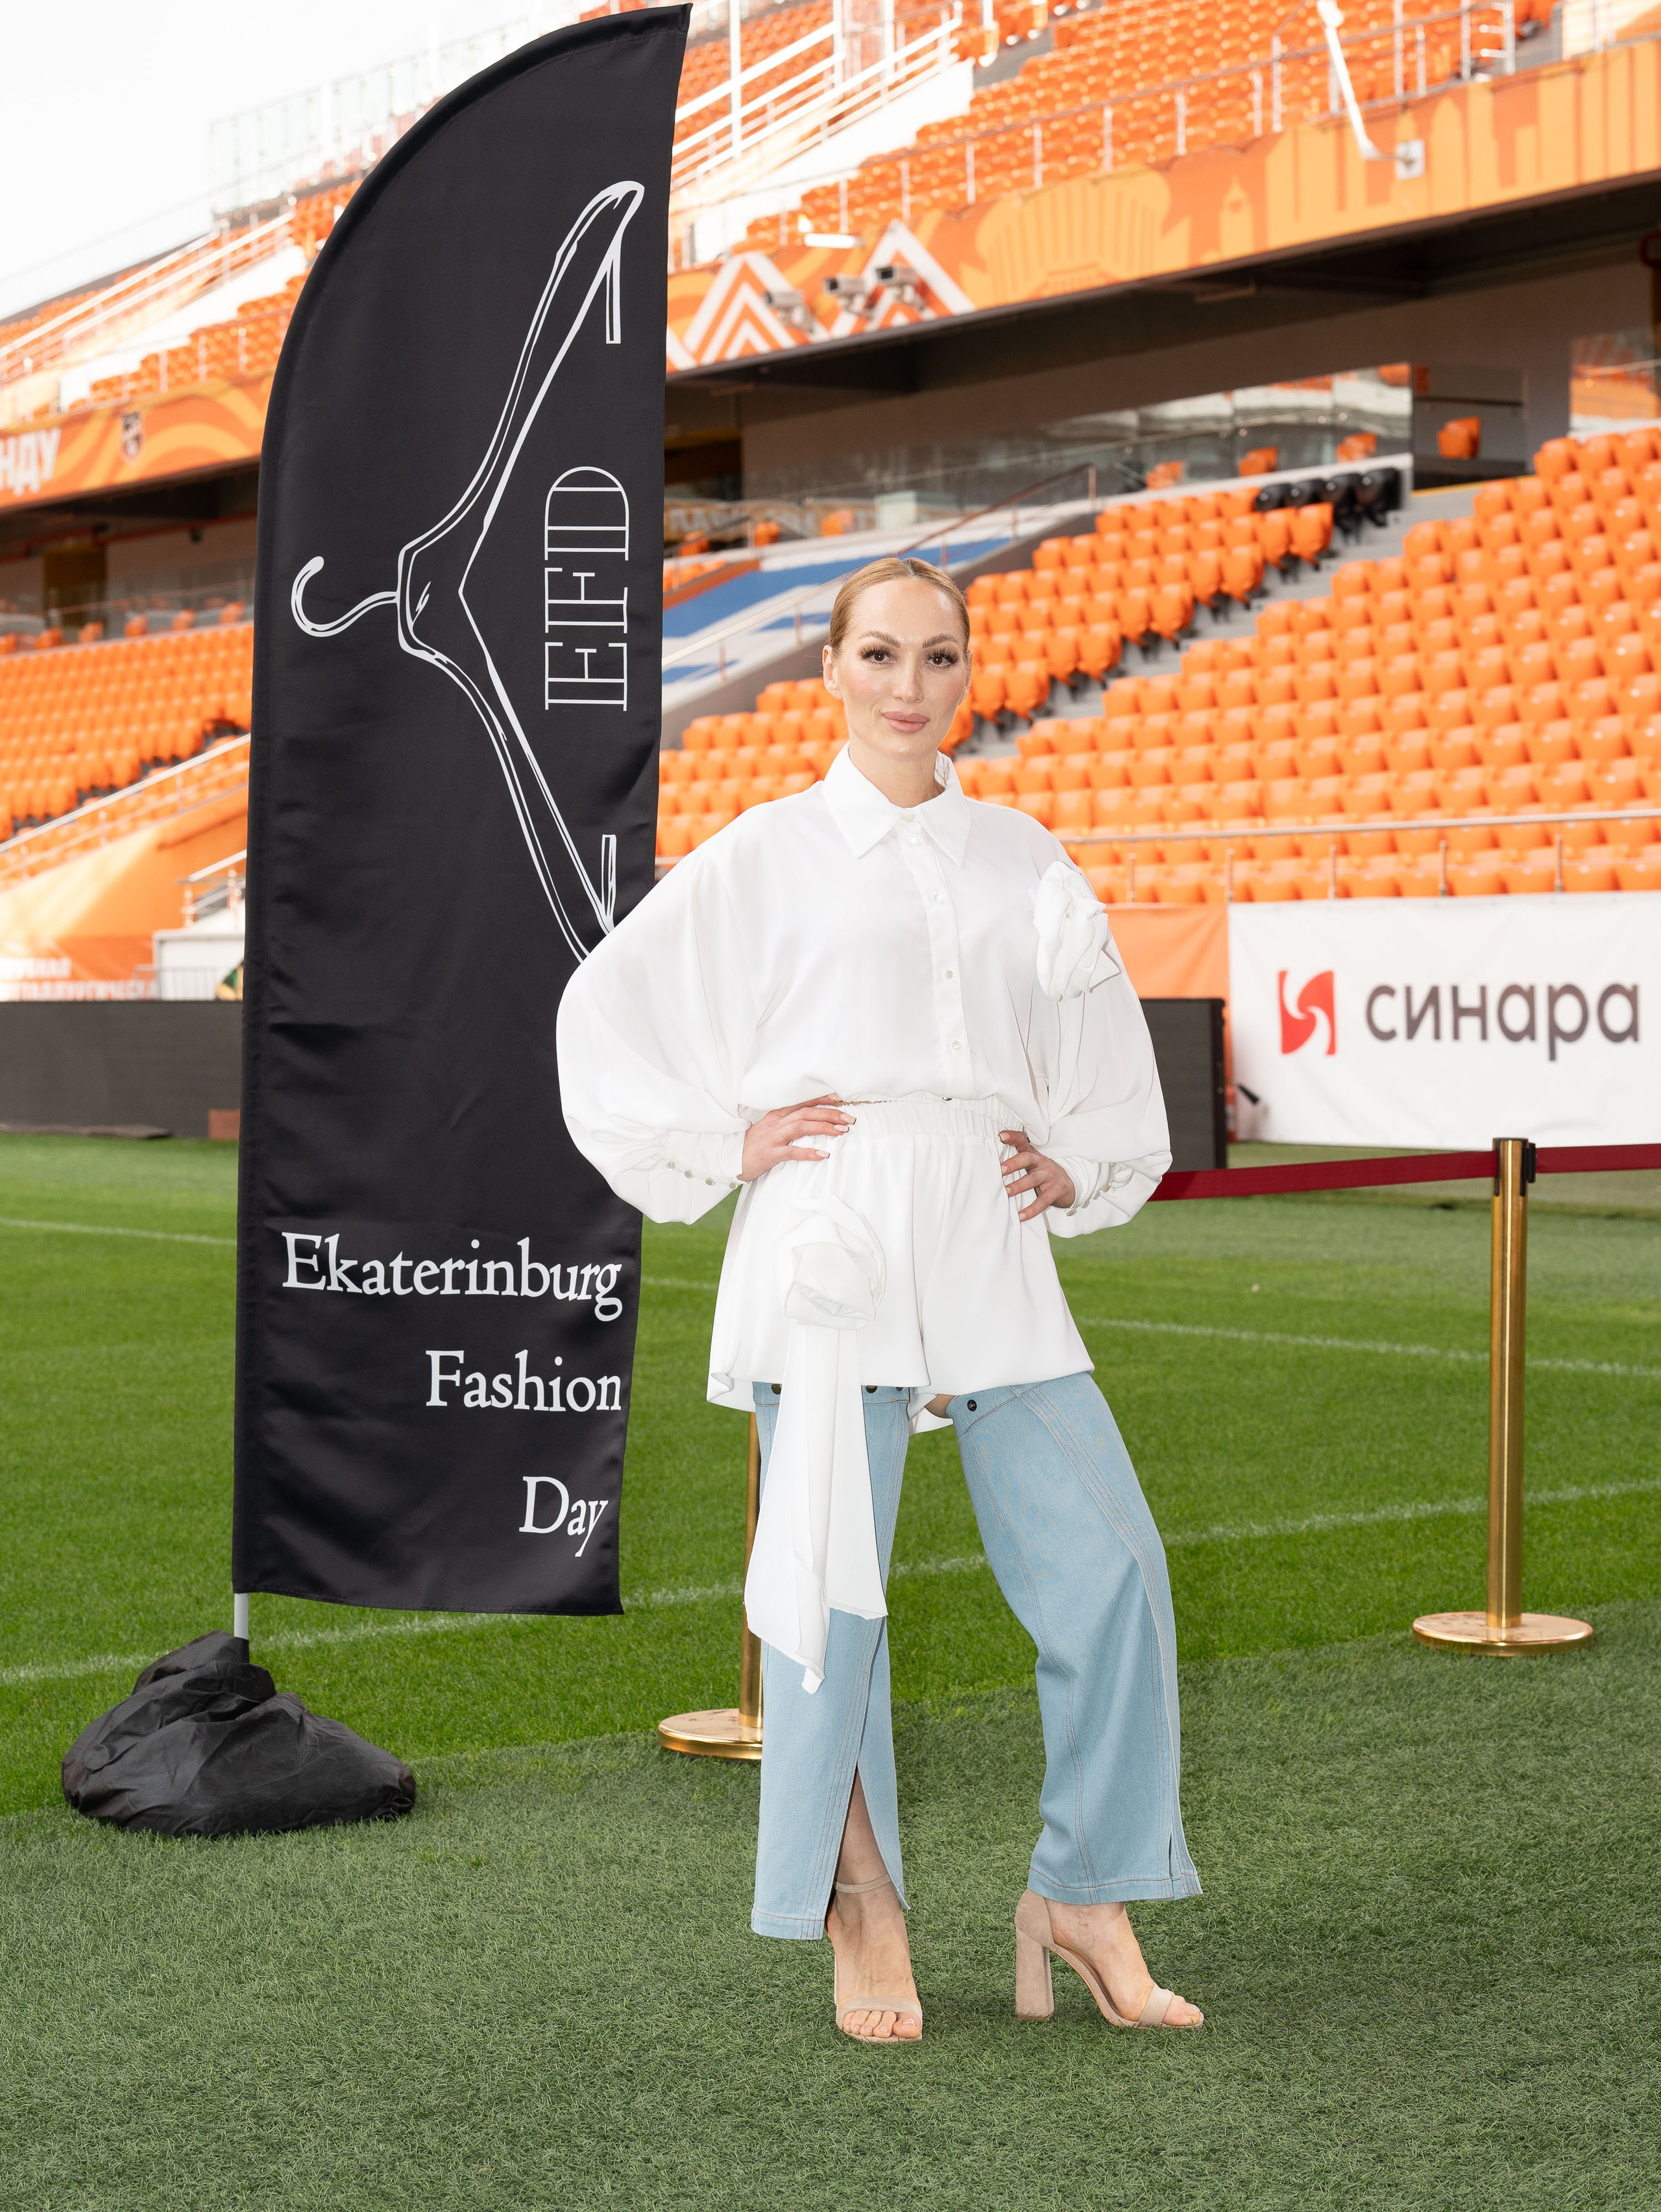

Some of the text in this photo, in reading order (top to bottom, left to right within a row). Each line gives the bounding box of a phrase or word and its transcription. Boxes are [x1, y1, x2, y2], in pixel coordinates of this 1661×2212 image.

[544, 466, 629, 712] EFD
[1365, 983, 1640, 1062] синара
[282, 1232, 623, 1322] Ekaterinburg
[425, 1349, 622, 1412] Fashion
[518, 1476, 609, 1557] Day
